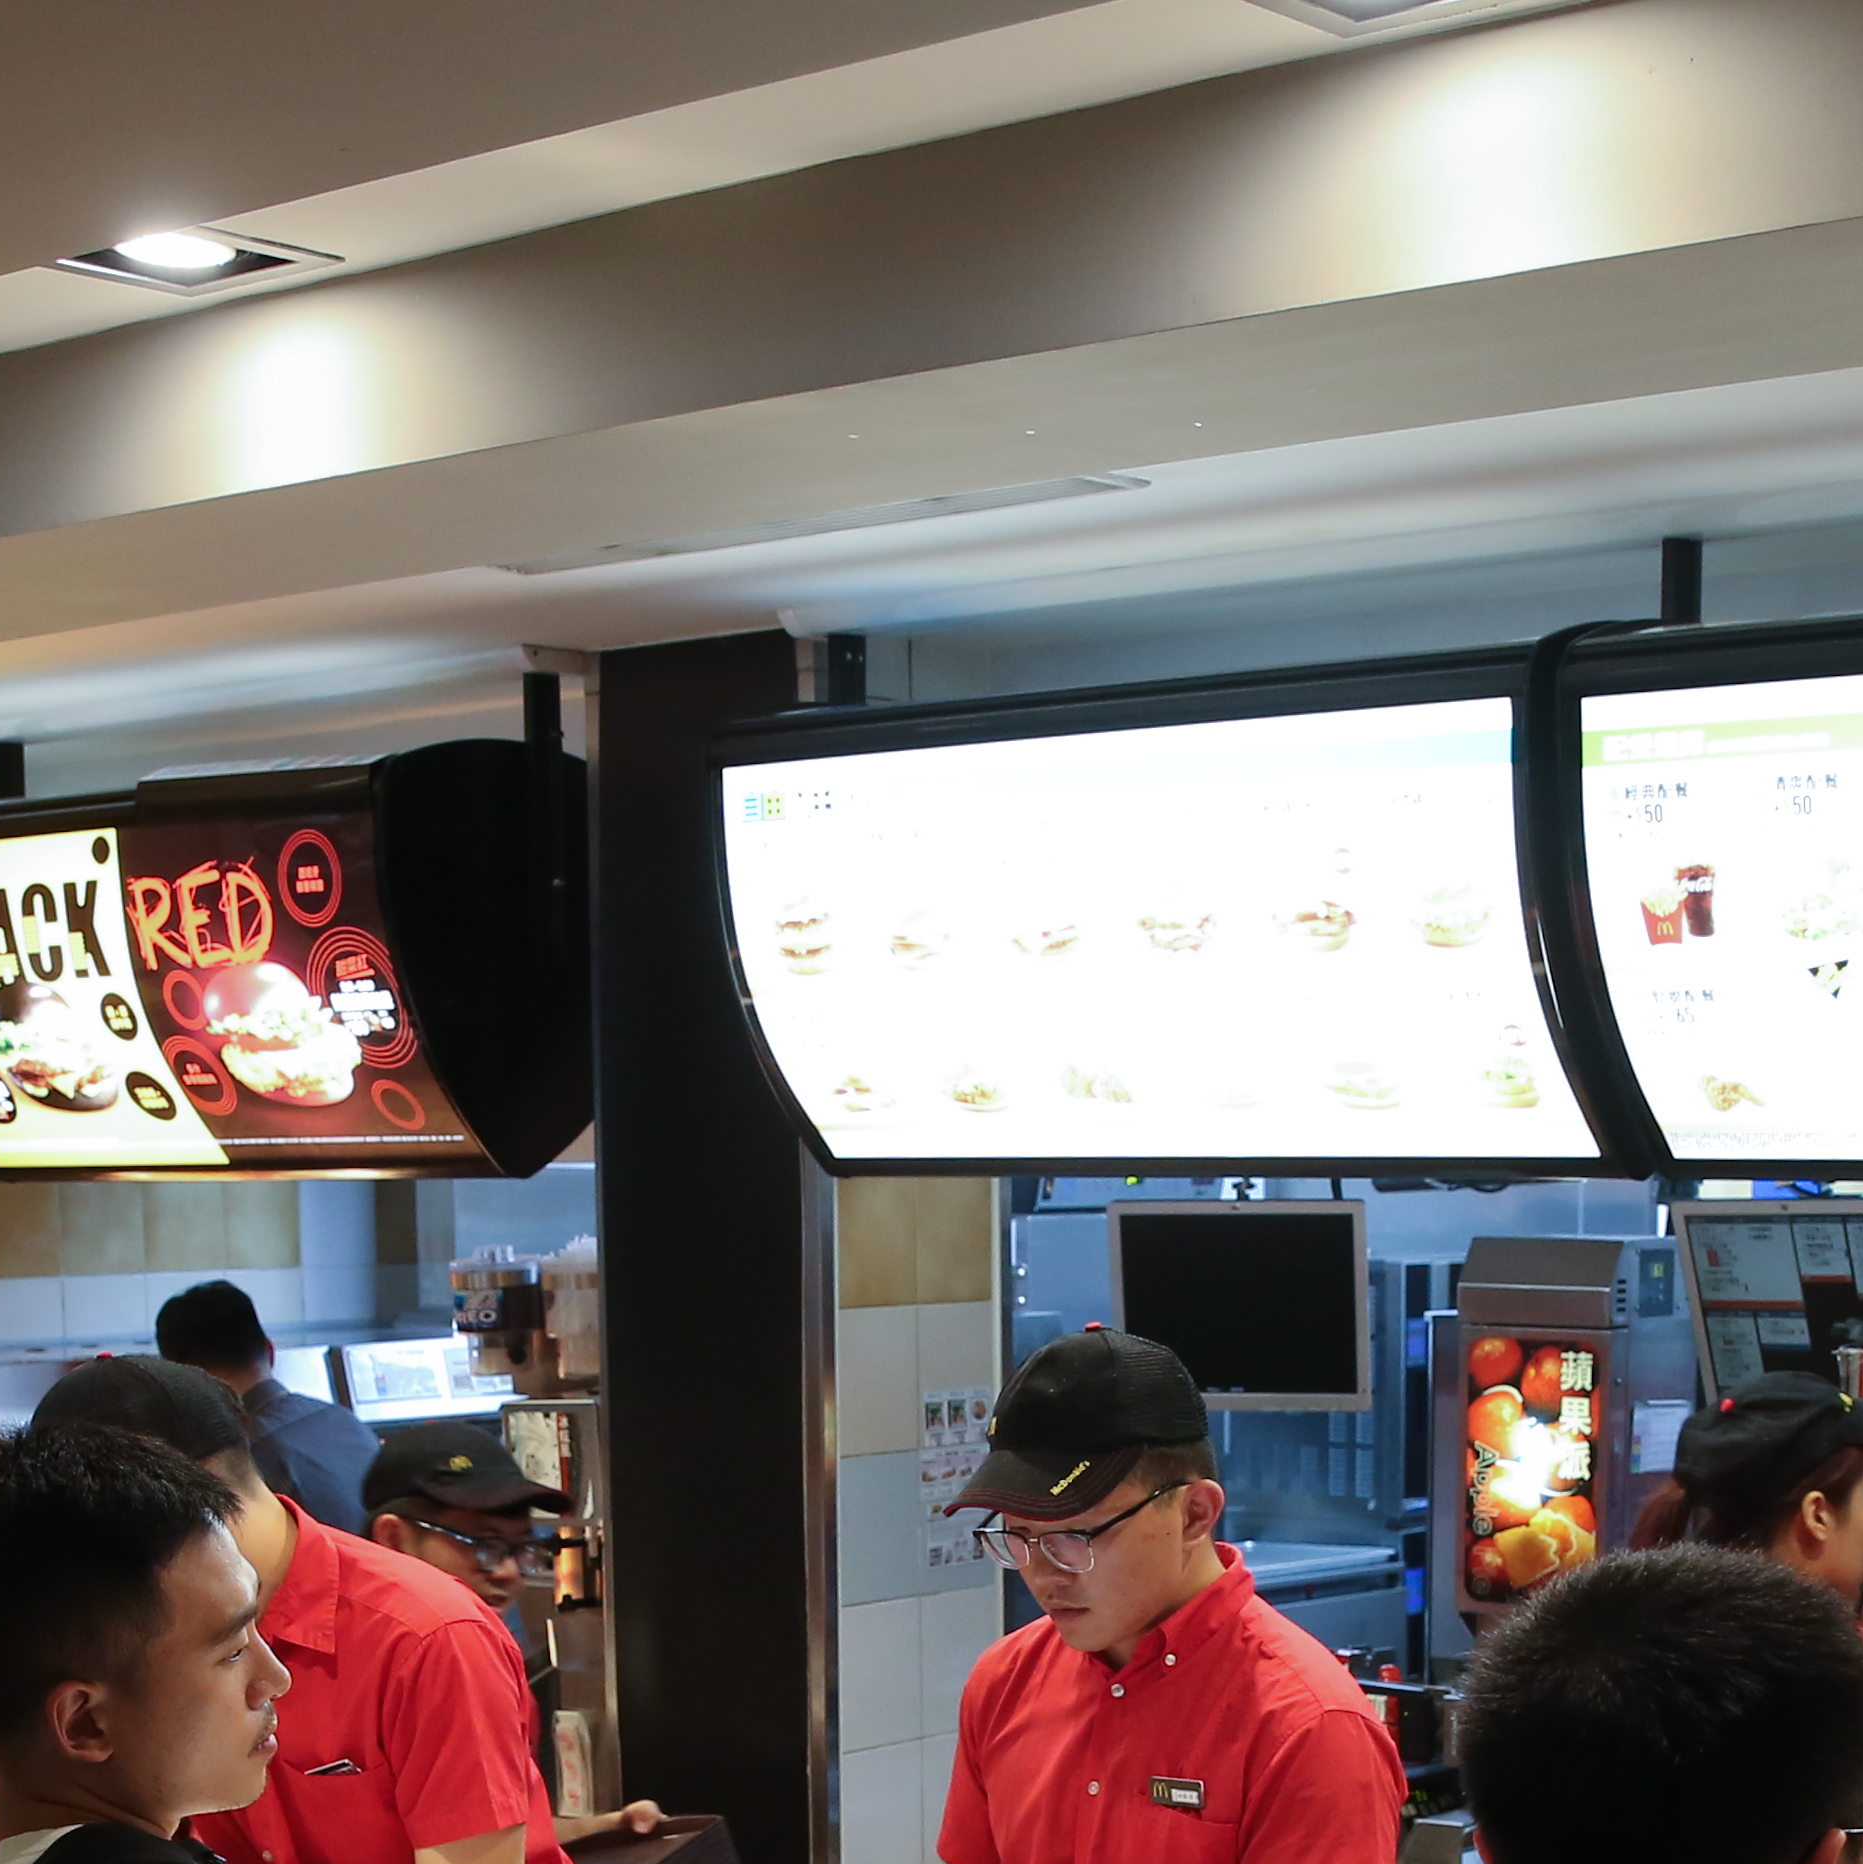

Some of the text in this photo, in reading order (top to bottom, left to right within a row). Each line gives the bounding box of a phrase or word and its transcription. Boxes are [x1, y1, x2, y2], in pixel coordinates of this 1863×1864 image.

[127, 856, 274, 970] RED
[1558, 1351, 1594, 1482] 蘋果派
[1469, 1440, 1500, 1536] Apple
